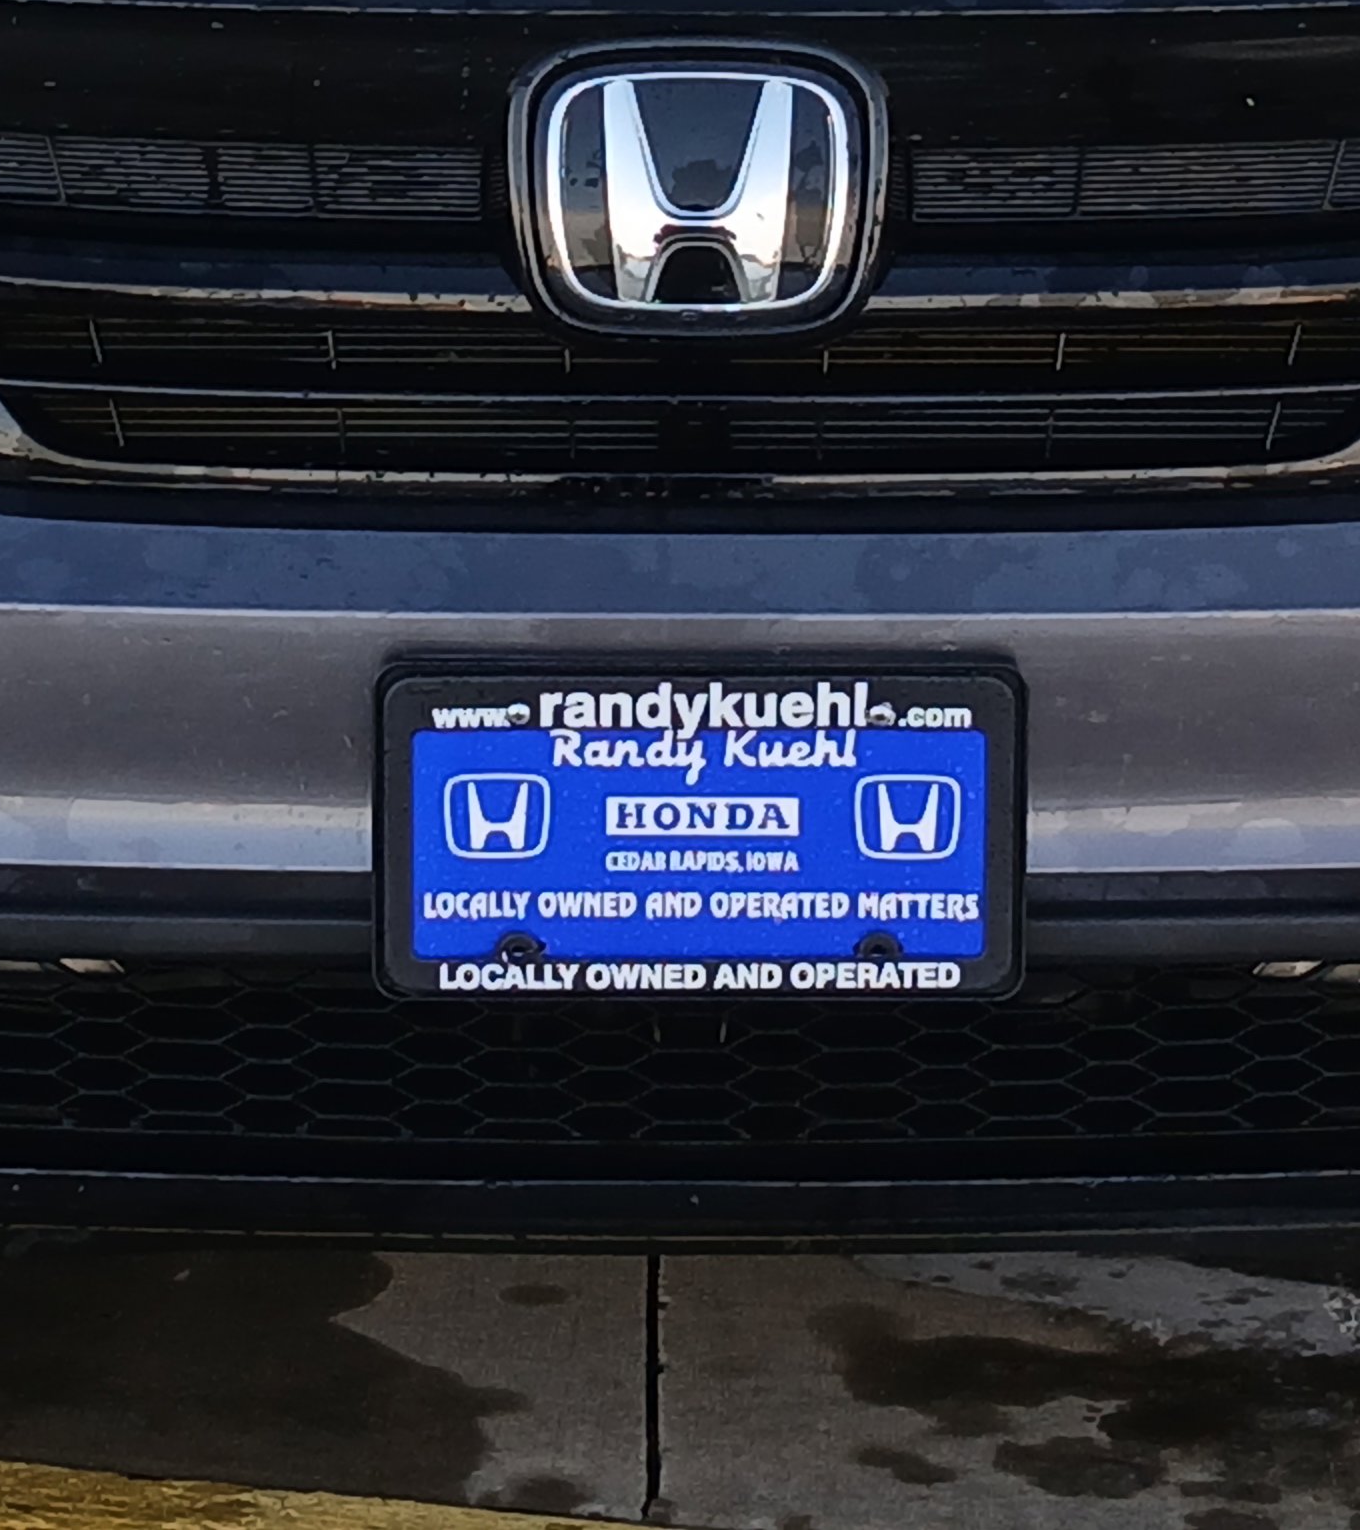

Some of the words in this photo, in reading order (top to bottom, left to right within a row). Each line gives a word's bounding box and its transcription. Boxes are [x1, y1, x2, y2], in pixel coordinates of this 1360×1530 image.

[539, 682, 869, 739] randykuehl
[549, 728, 707, 786] Randy
[723, 728, 857, 768] Kuehl
[615, 802, 791, 831] HONDA
[605, 850, 666, 872] CEDAR
[746, 850, 800, 872] IOWA
[423, 890, 532, 920] LOCALLY
[537, 890, 638, 919] OWNED
[645, 890, 703, 920] AND
[709, 891, 850, 921] OPERATED
[857, 891, 979, 921] MATTERS
[439, 962, 580, 991] LOCALLY
[585, 962, 707, 991] OWNED
[713, 962, 783, 990] AND
[790, 961, 961, 990] OPERATED
